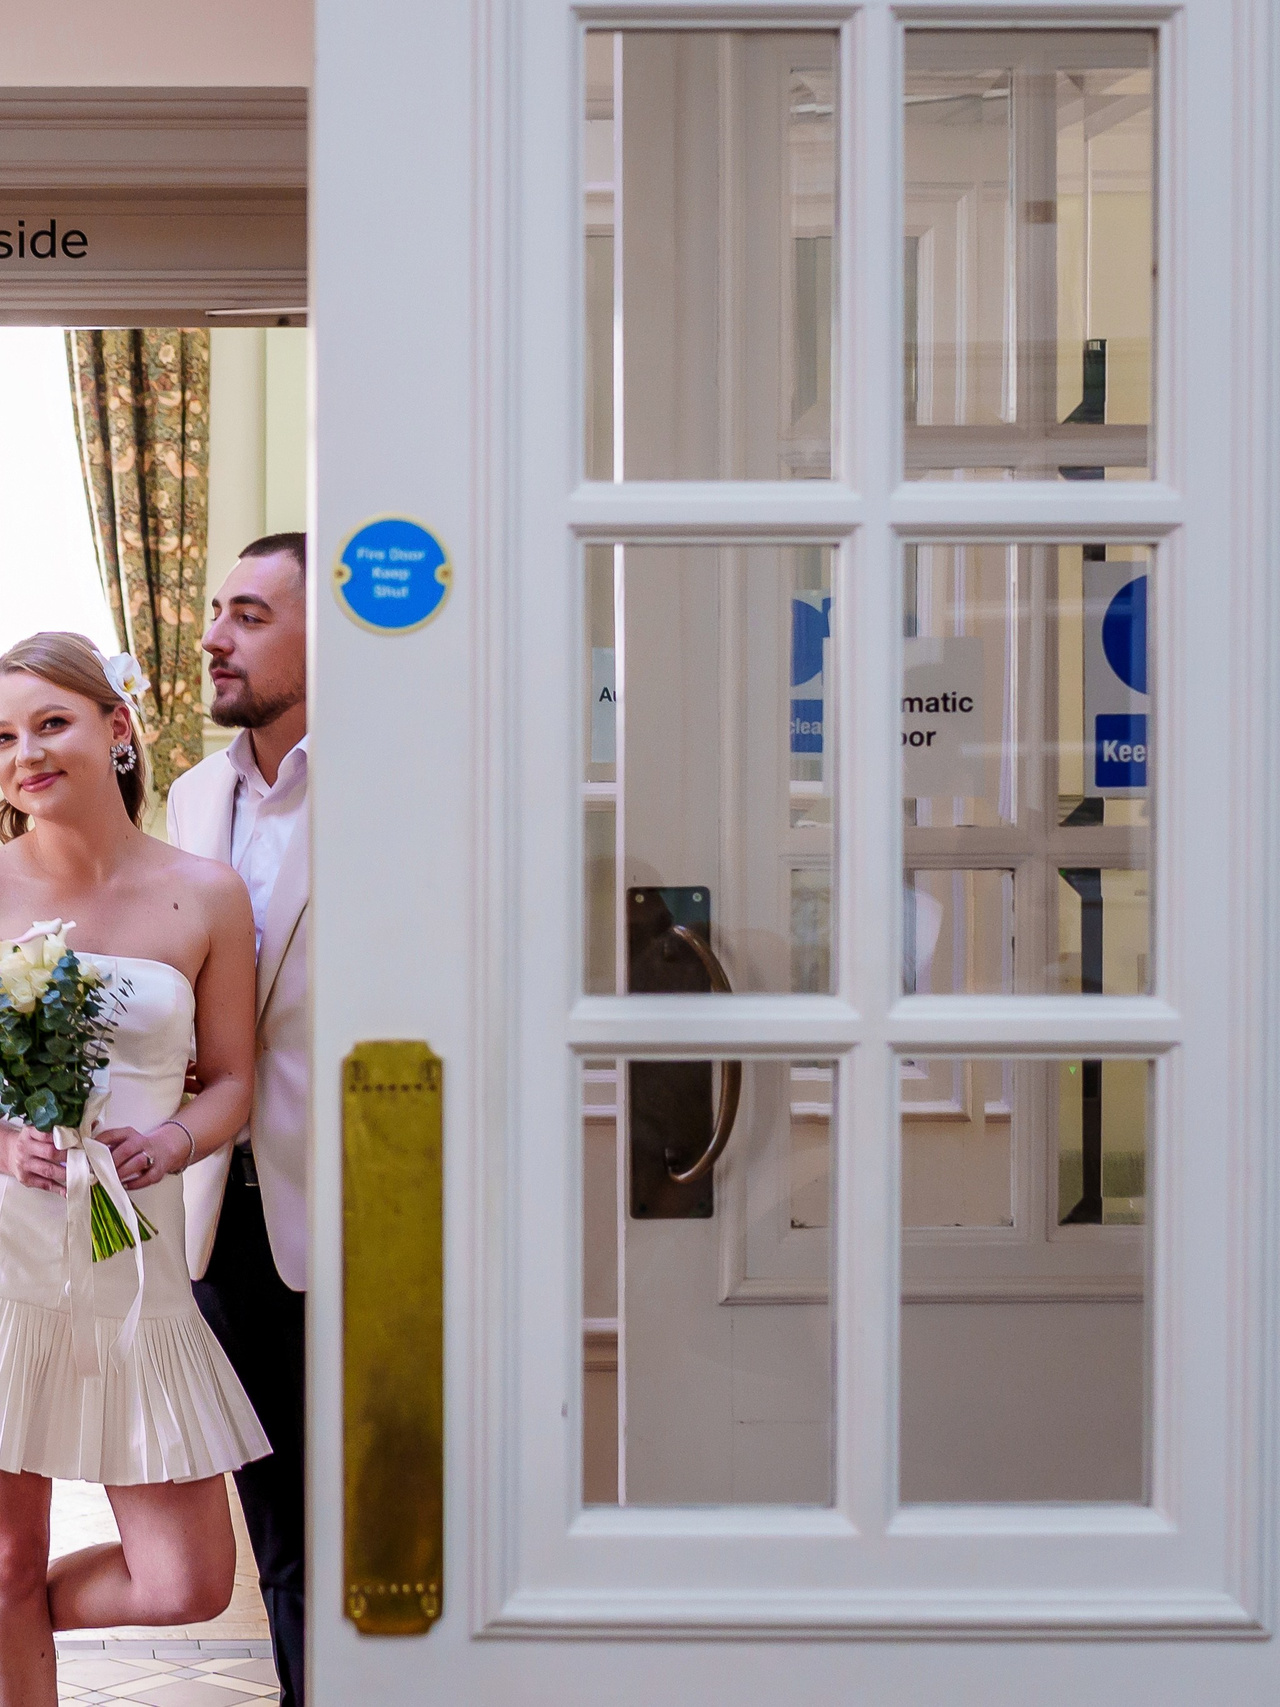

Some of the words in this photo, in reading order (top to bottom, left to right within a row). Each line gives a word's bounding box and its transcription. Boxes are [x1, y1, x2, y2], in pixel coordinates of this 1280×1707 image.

[599, 686, 616, 702] A
[901, 691, 974, 713] matic
[1103, 739, 1146, 763] Kee
